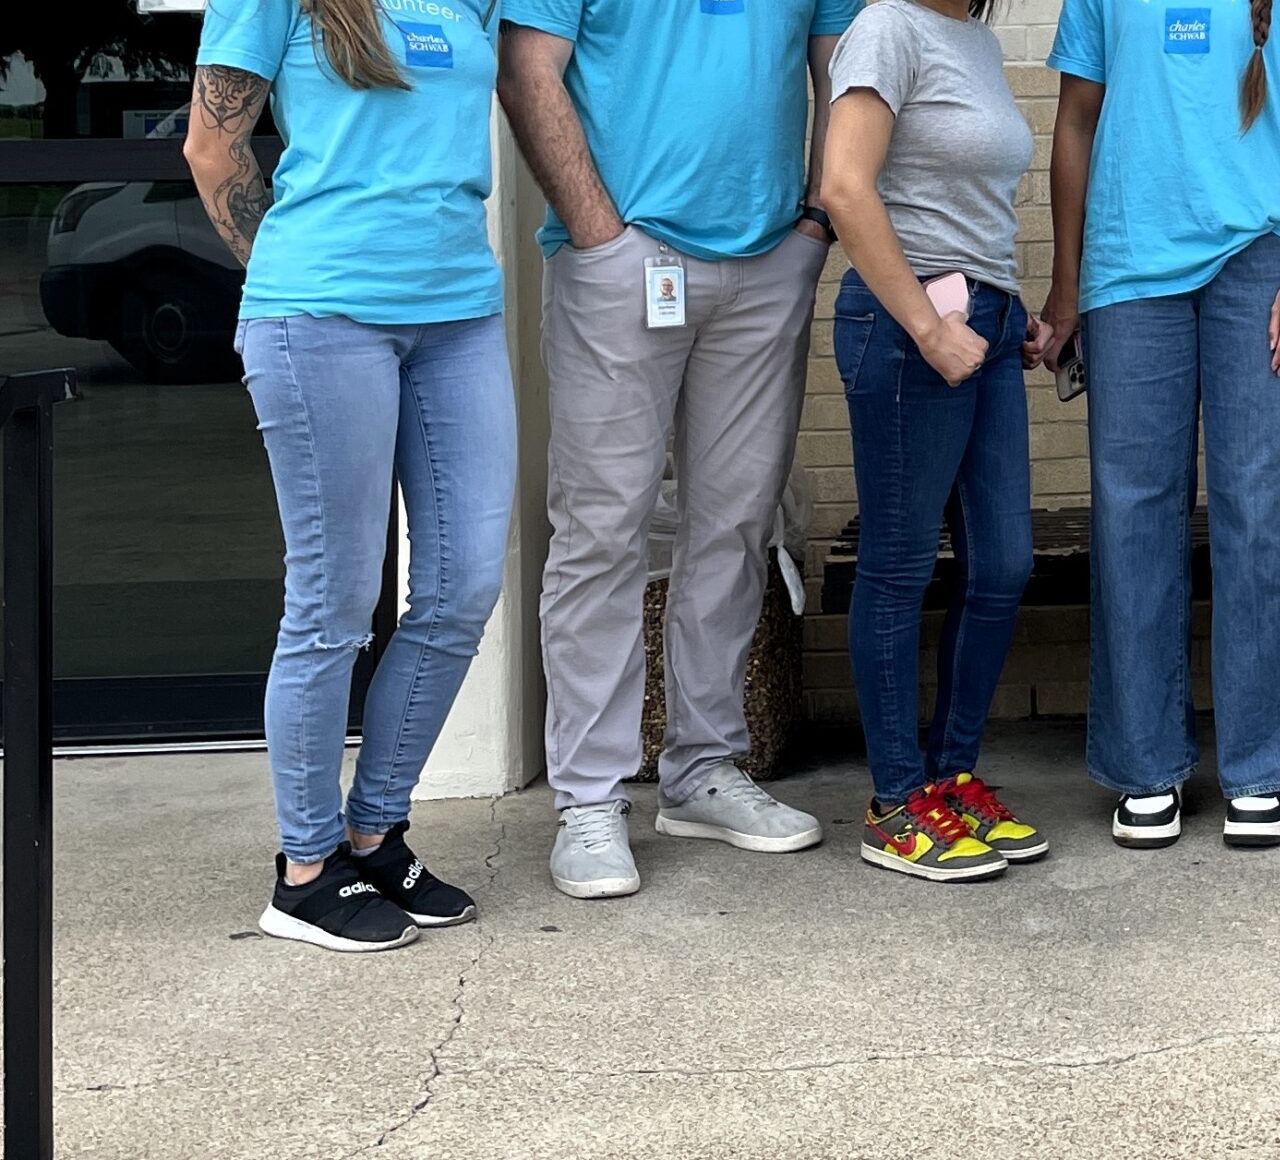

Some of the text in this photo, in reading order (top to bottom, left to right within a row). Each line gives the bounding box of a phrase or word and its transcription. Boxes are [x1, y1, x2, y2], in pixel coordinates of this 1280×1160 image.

[1168, 20, 1206, 32] charles
[1168, 32, 1206, 41] SCHWAB
[409, 42, 449, 53] SCHWAB
